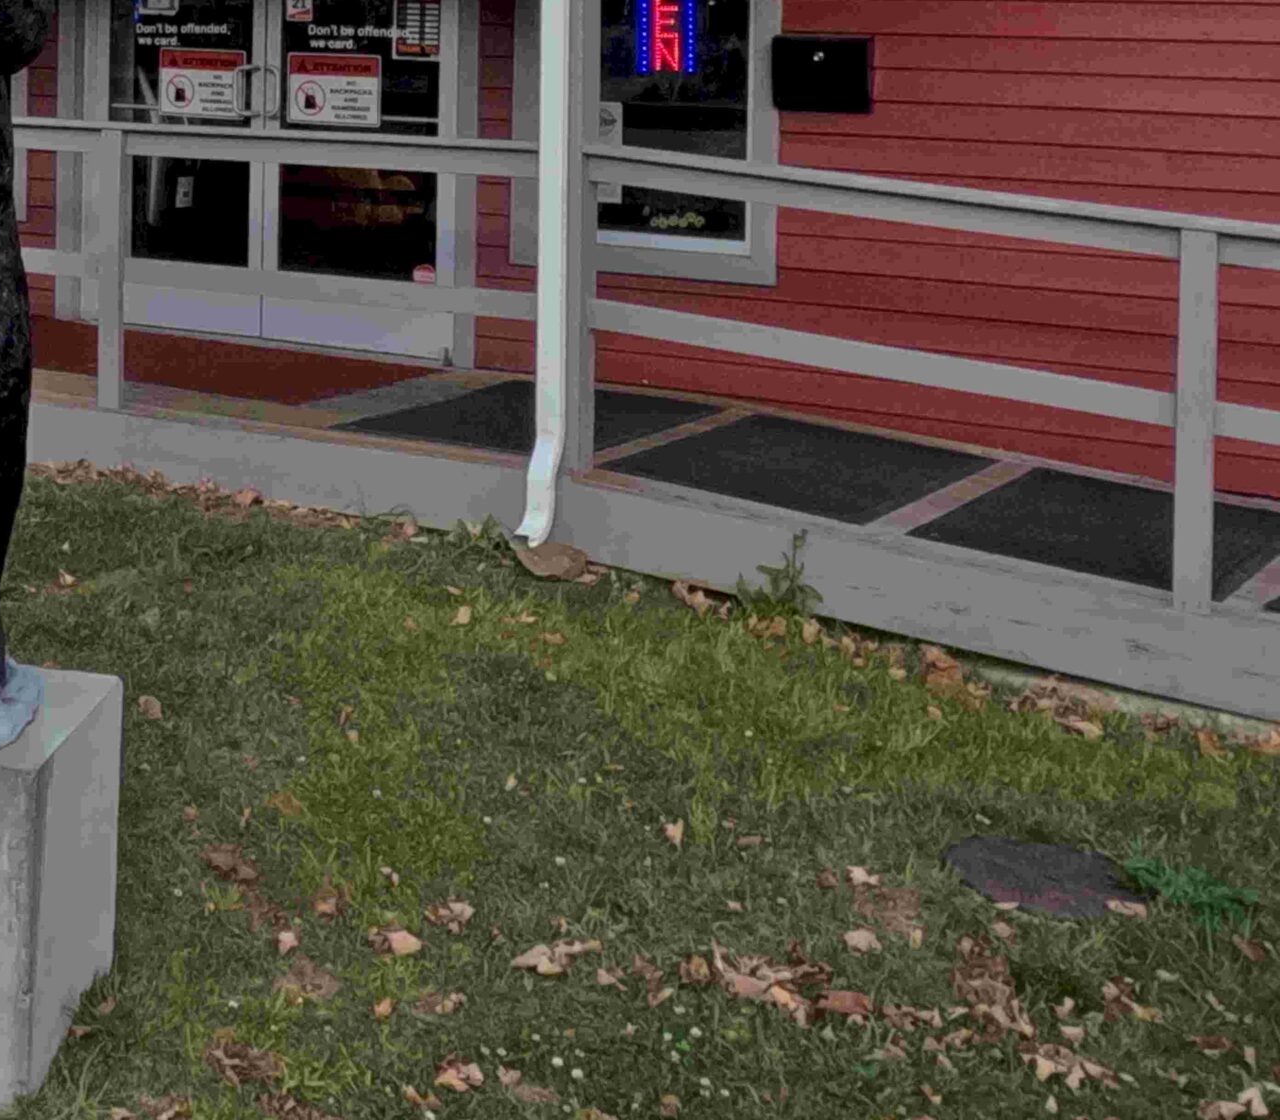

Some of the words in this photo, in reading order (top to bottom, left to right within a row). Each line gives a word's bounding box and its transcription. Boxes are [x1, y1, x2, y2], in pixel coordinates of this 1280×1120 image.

[135, 23, 163, 34] Don't
[164, 22, 178, 35] be
[307, 24, 338, 37] Don't
[339, 24, 356, 37] be
[137, 36, 152, 46] we
[308, 38, 327, 49] we
[311, 62, 372, 74] ATTENTION
